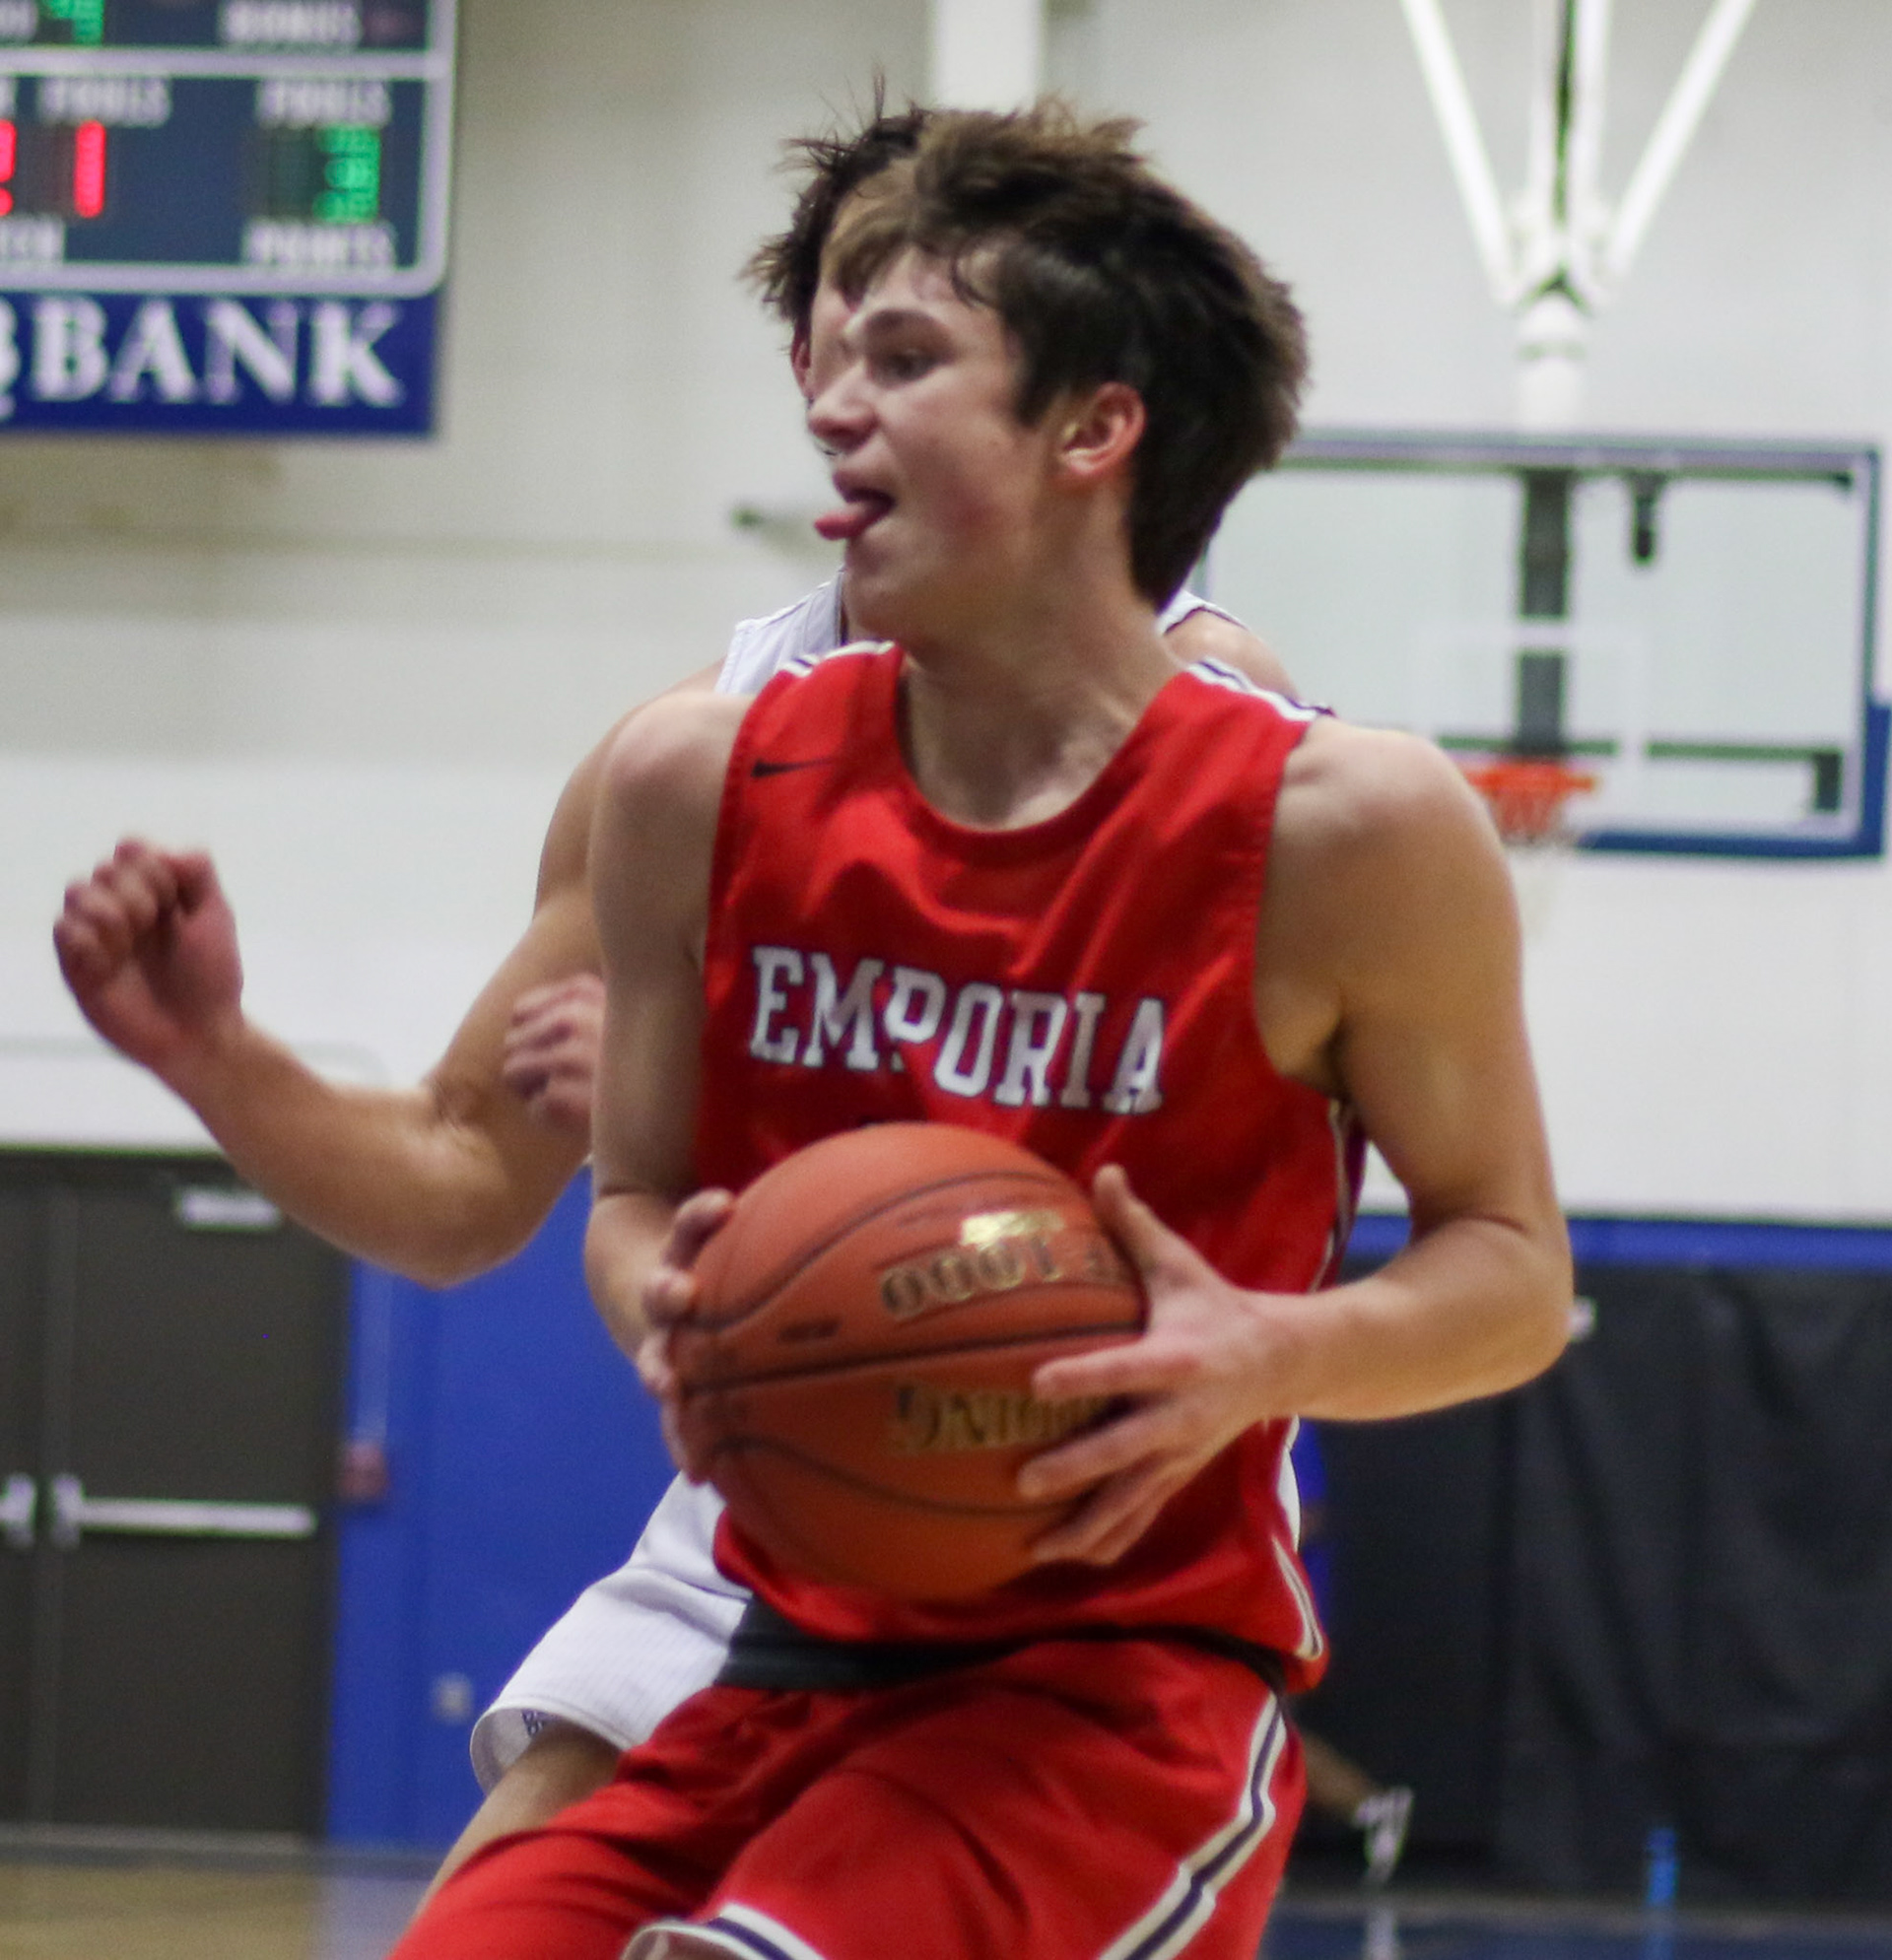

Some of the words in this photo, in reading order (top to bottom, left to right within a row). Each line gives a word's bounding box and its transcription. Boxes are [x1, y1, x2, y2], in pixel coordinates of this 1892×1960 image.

[75, 119, 105, 218] 1
[33, 298, 404, 407] BANK
[749, 944, 1165, 1115] EMPORIA
